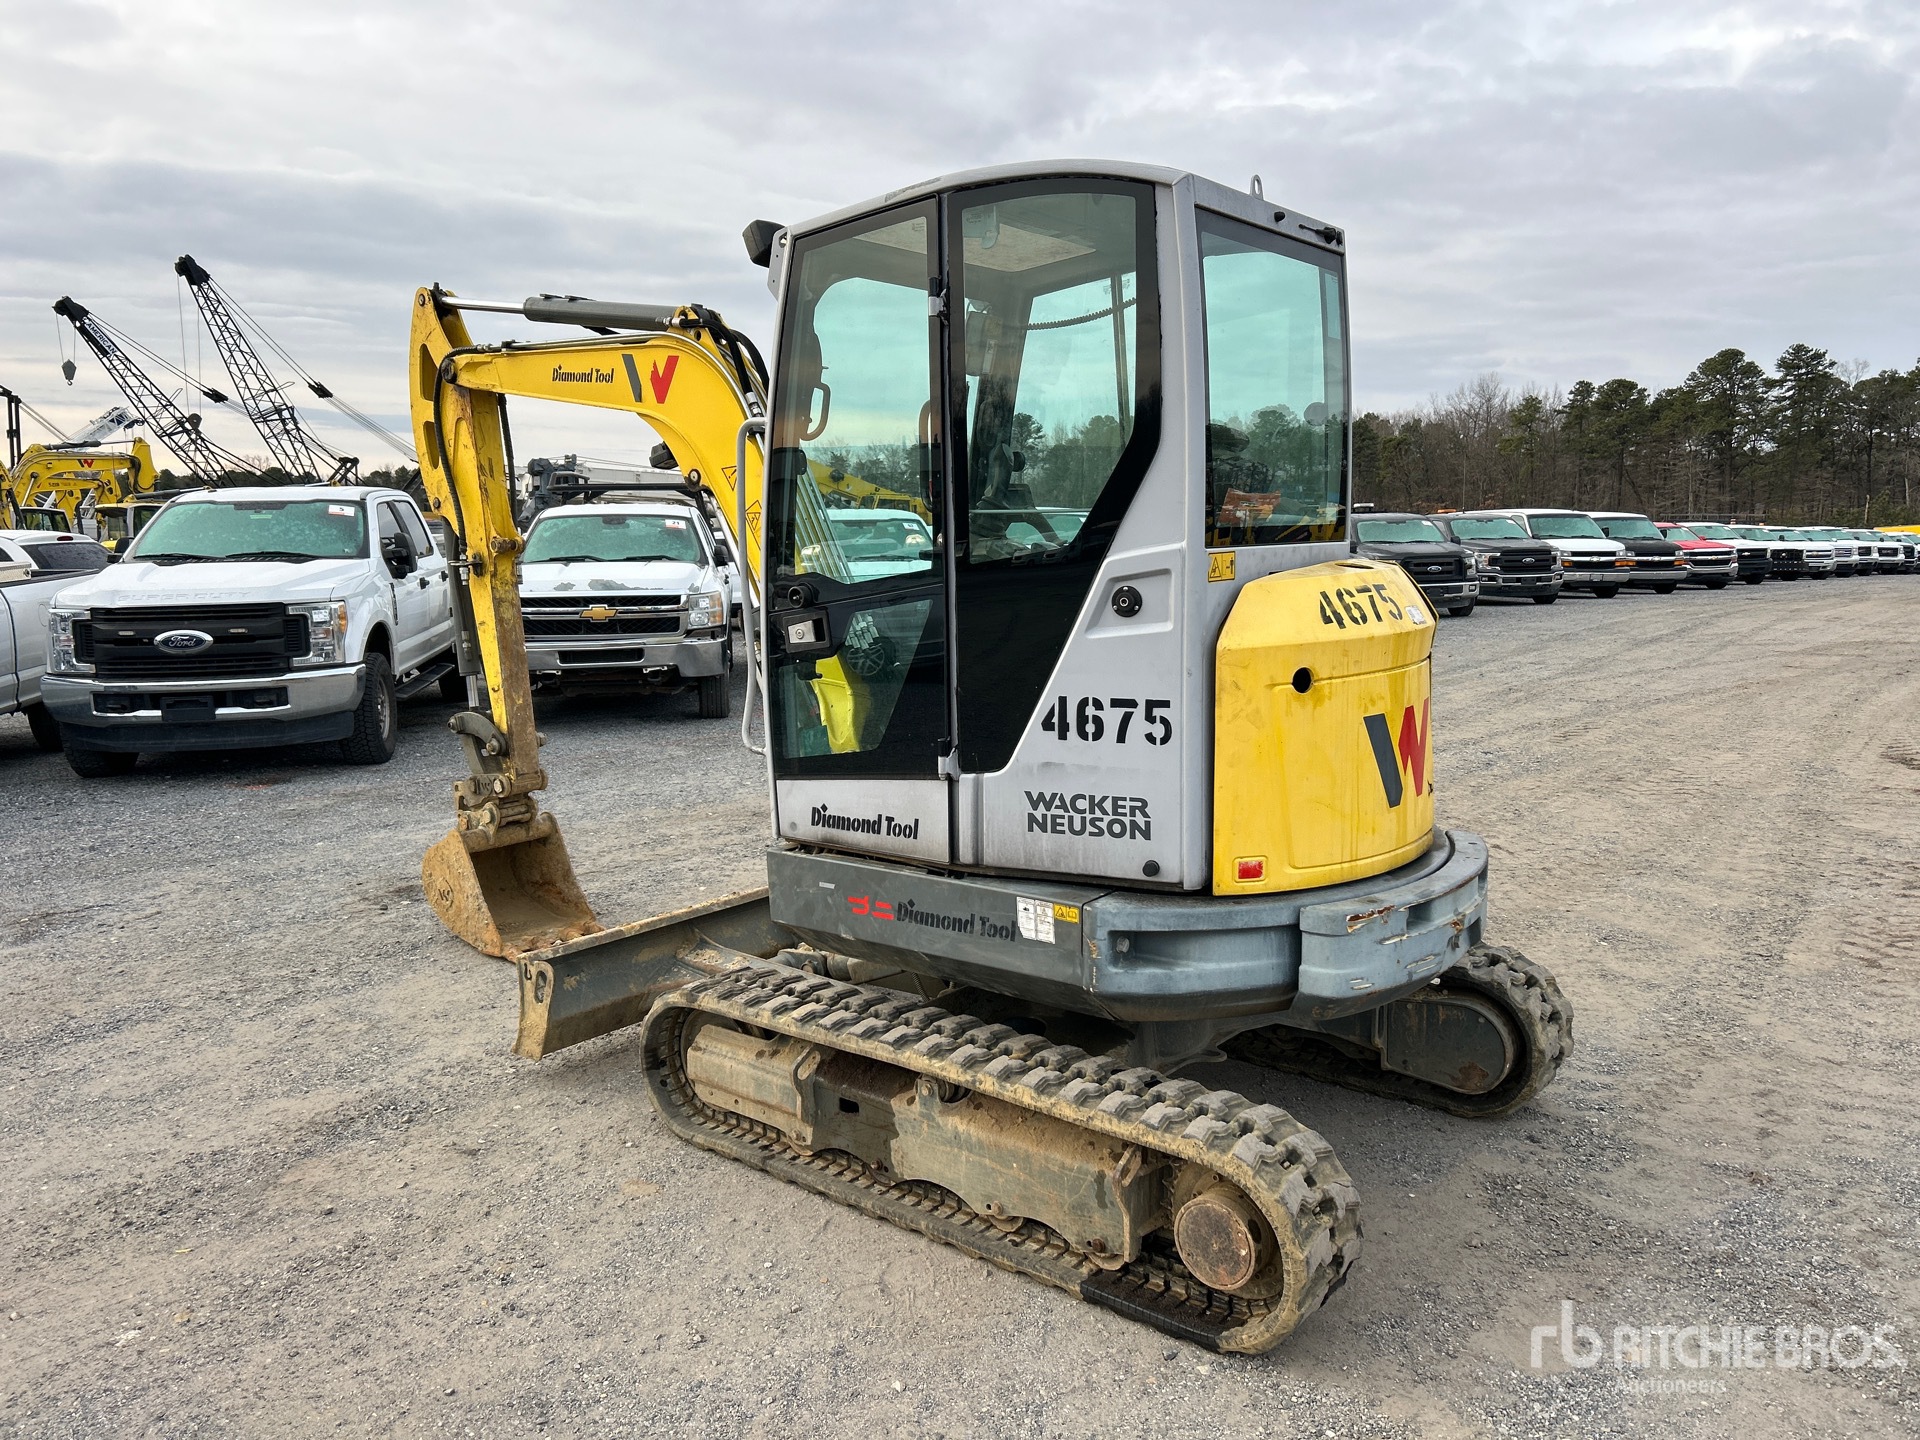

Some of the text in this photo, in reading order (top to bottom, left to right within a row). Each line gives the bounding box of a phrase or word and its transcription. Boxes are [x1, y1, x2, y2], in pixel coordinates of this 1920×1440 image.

[86, 321, 117, 355] AMERICAN
[552, 364, 615, 384] Diamond Tool
[118, 590, 251, 602] SUPER DUTY
[1319, 583, 1403, 630] 4675
[168, 635, 197, 648] Ford
[1040, 695, 1173, 746] 4675
[1024, 790, 1152, 819] WACKER
[810, 803, 920, 840] Diamond Tool
[1027, 812, 1152, 841] NEUSON
[896, 898, 976, 935] Diamond
[979, 915, 1017, 942] Tool
